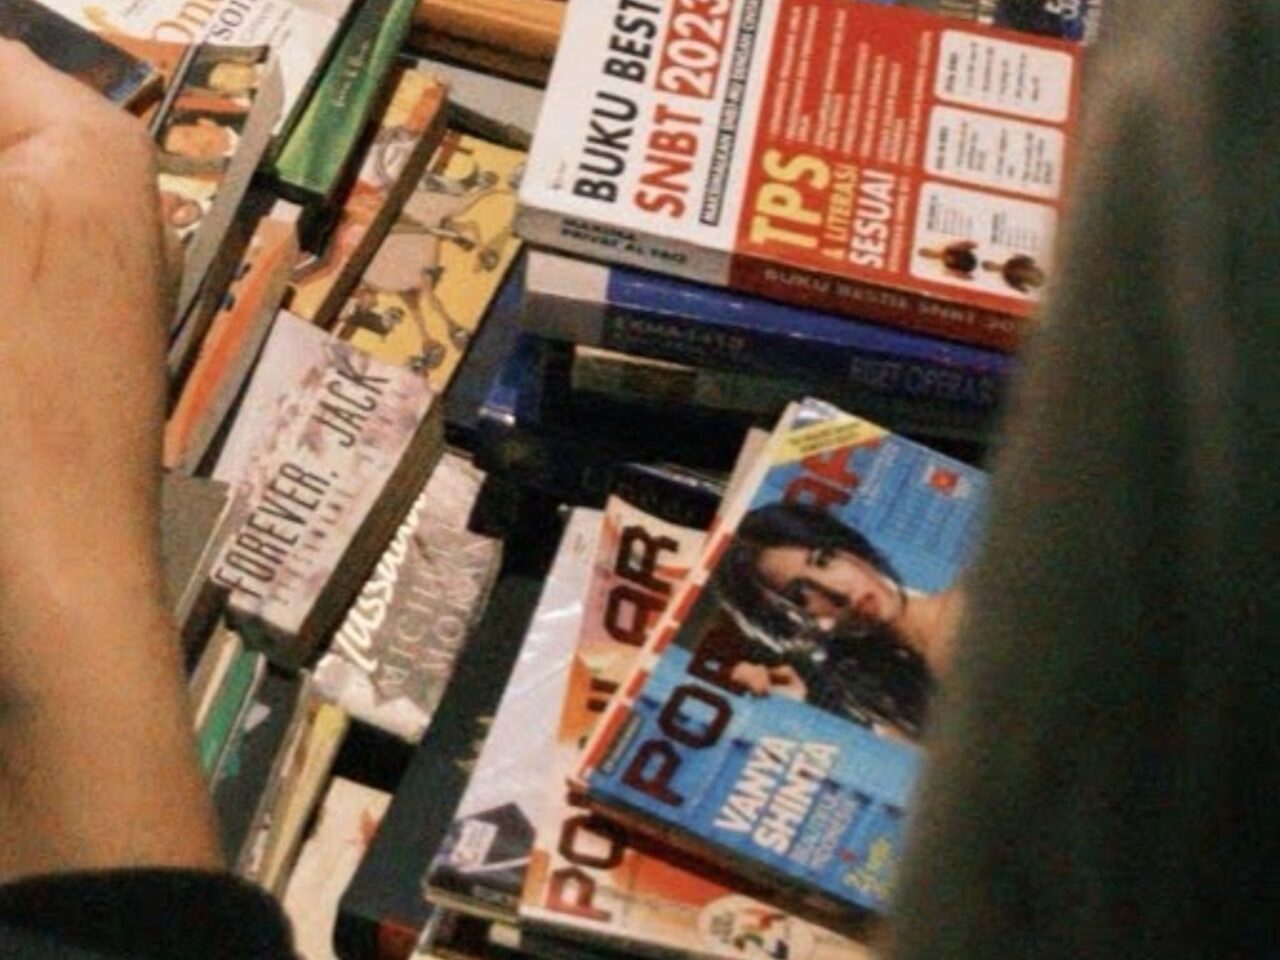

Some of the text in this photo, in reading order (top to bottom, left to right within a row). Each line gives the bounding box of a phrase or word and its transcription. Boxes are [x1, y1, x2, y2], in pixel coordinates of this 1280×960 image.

[574, 102, 638, 204] BUKU
[635, 100, 702, 220] SNBT
[751, 148, 832, 250] TPS
[823, 164, 860, 236] LITERASI
[849, 169, 895, 270] SESUAI
[312, 353, 391, 447] JACK
[713, 735, 796, 833] VANYA
[753, 742, 840, 854] SHINTA
